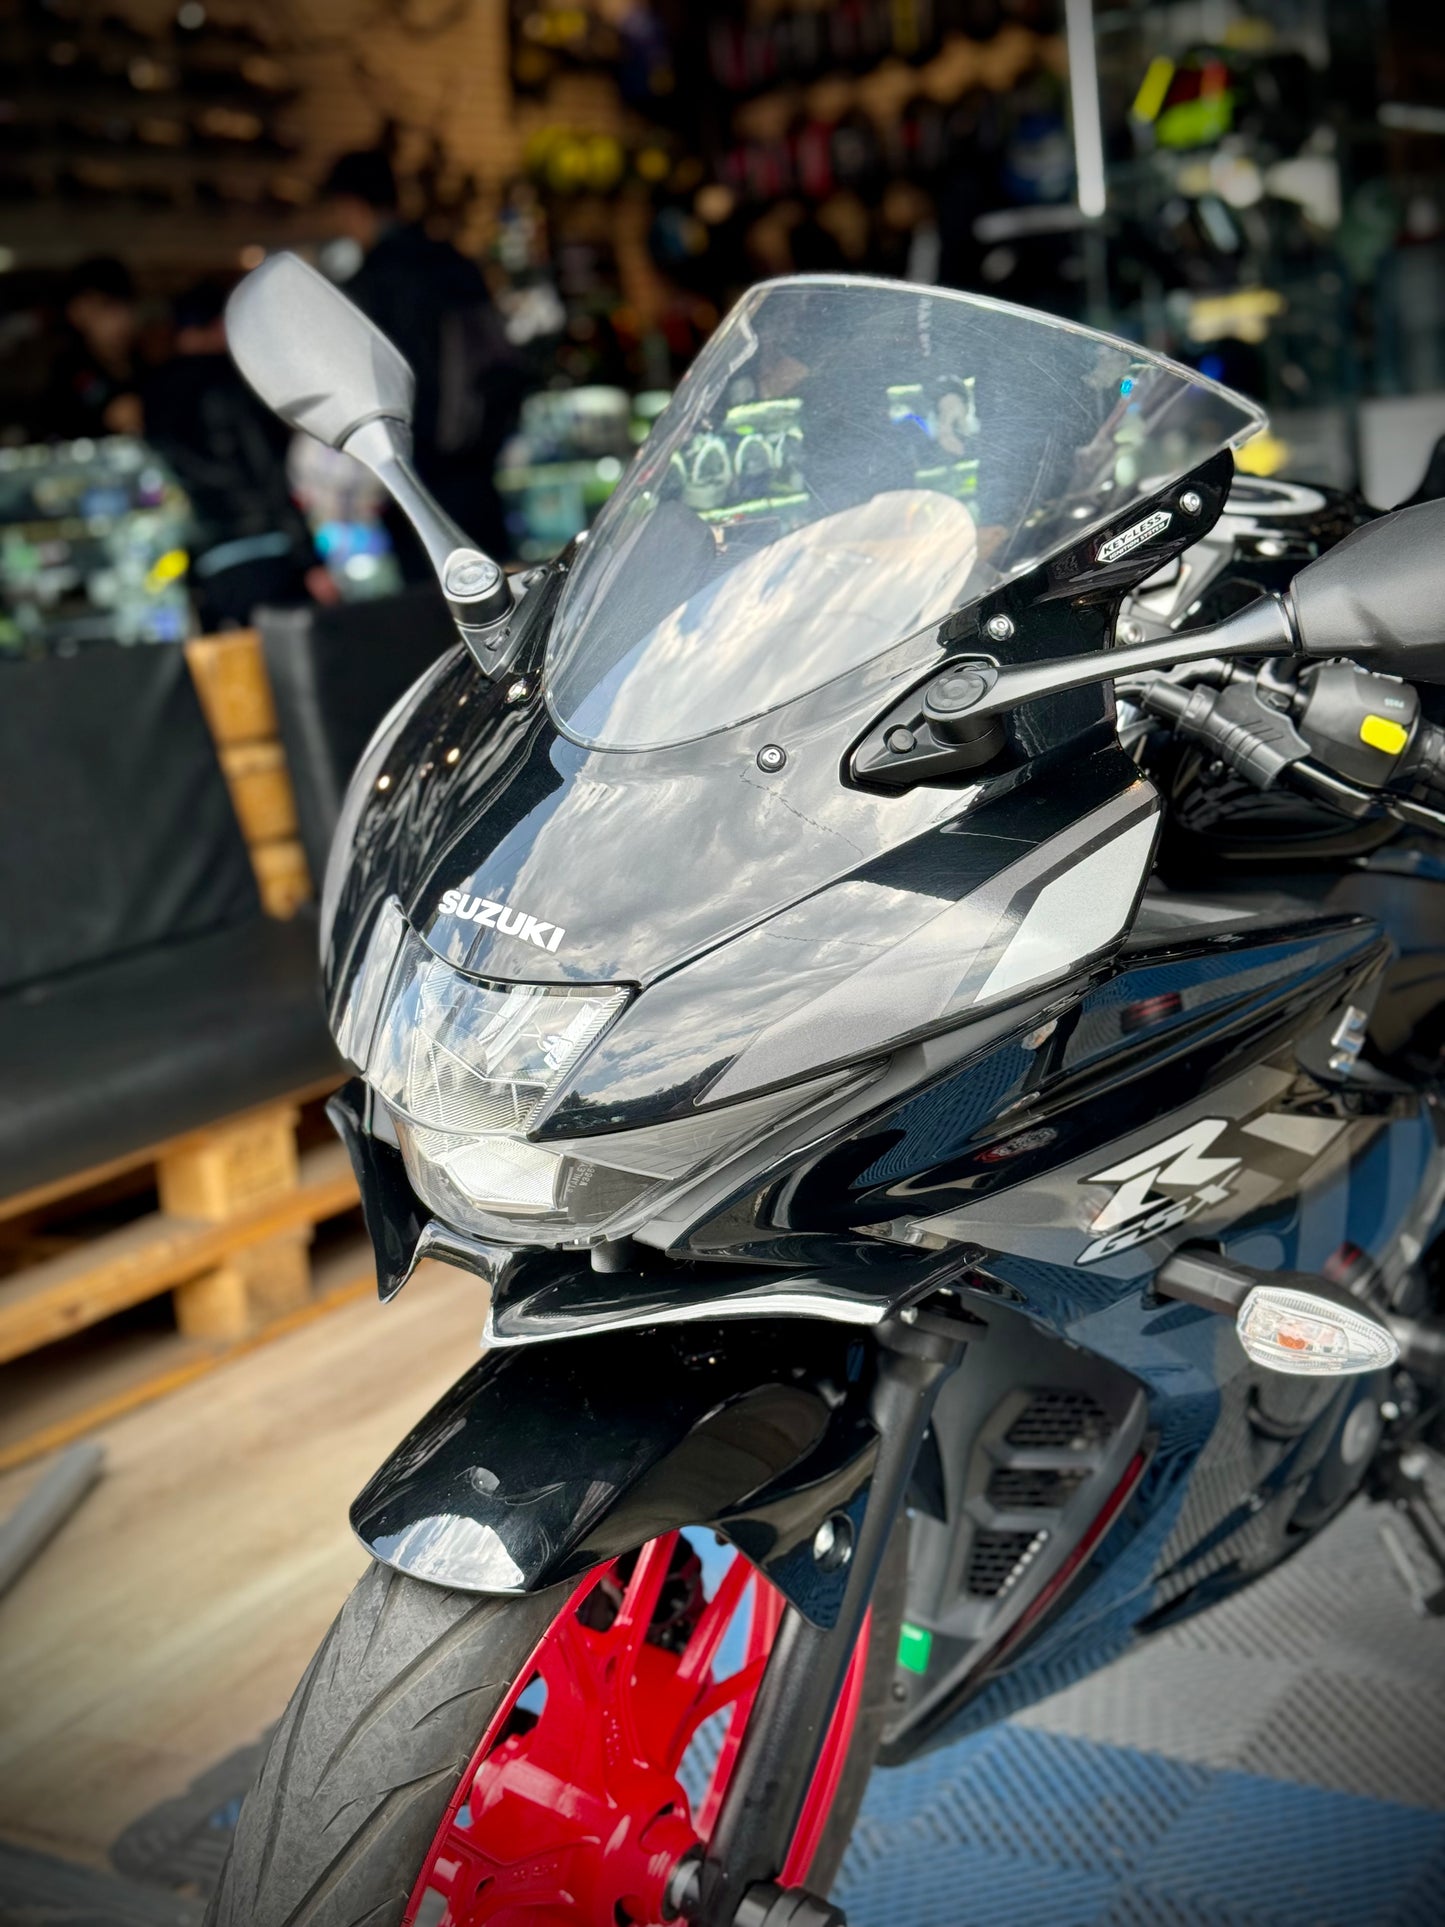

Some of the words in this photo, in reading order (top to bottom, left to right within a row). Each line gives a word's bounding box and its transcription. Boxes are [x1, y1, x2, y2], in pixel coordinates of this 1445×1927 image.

[1103, 513, 1162, 555] KEY-LESS
[1109, 538, 1140, 560] IGNITION
[438, 889, 566, 953] SUZUKI
